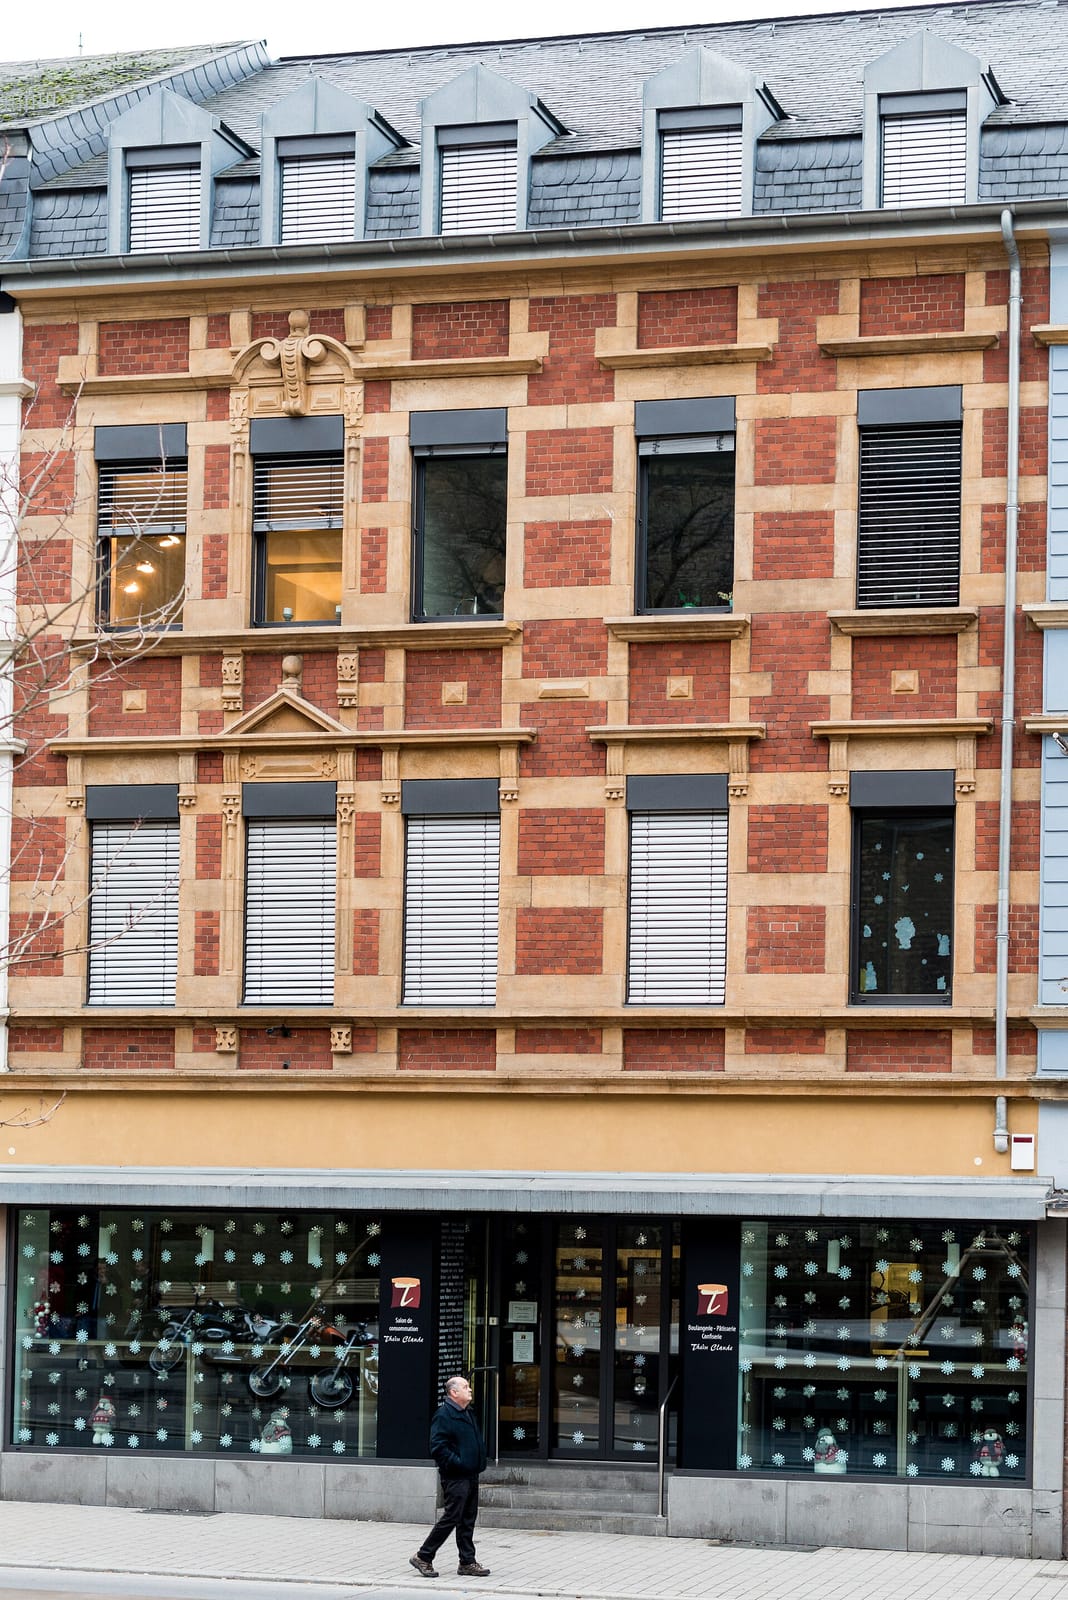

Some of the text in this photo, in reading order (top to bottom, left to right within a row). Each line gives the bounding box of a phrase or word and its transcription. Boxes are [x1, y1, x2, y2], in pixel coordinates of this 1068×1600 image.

[688, 1324, 713, 1332] Boulangerie
[402, 1335, 424, 1343] Claude
[710, 1343, 733, 1351] Claude
